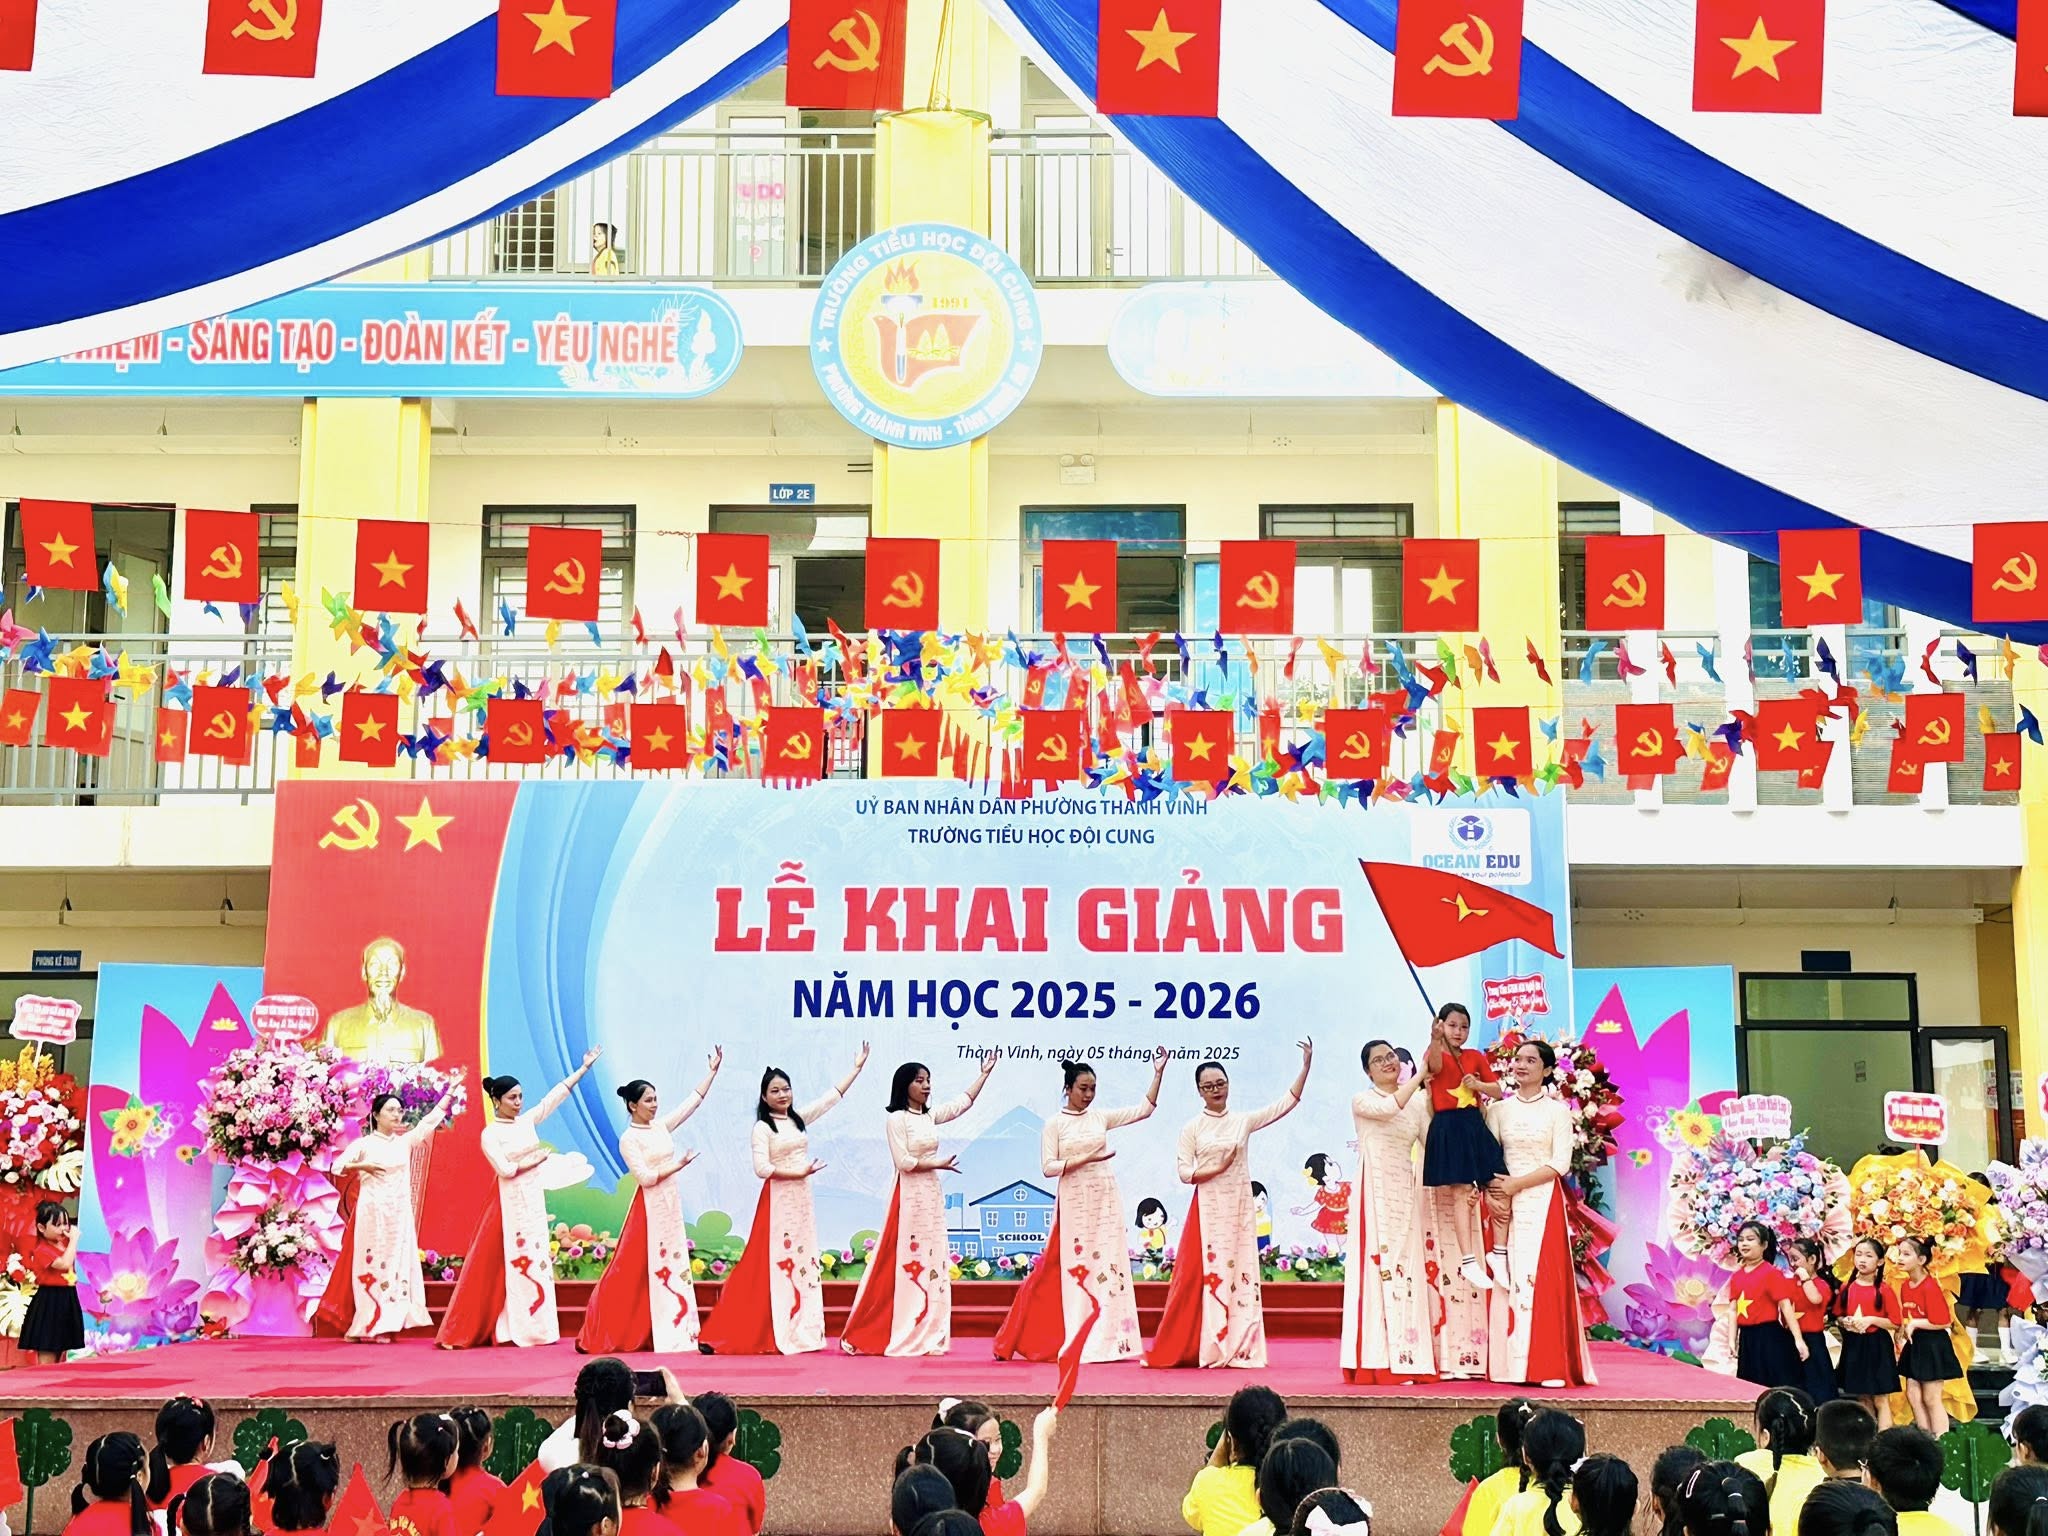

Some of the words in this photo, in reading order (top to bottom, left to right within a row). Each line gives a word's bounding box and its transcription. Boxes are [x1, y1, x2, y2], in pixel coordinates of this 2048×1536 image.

[869, 226, 916, 258] TIỂU
[922, 231, 966, 252] HỌC
[969, 243, 1004, 274] ĐỘI
[1002, 272, 1033, 330] CUNG
[280, 321, 333, 370] TẠO
[363, 314, 443, 362] ĐOÀN
[454, 310, 506, 362] KẾT
[537, 315, 589, 363] YÊU
[600, 311, 676, 363] NGHỀ
[909, 425, 942, 441] VINH
[773, 486, 793, 499] LỚP
[796, 489, 810, 499] 2E
[856, 795, 879, 815] UỶ
[884, 799, 920, 815] BAN
[924, 797, 974, 815] NHÂN
[979, 798, 1016, 815] DÂN
[1021, 796, 1097, 815] PHƯỜNG
[1165, 800, 1207, 815] VINH
[908, 826, 981, 844] TRƯỜNG
[986, 824, 1022, 844] TIỂU
[1028, 828, 1065, 848] HỌC
[1069, 826, 1101, 848] ĐỘI
[1105, 828, 1155, 844] CUNG
[1422, 854, 1480, 869] OCEAN
[1486, 854, 1520, 869] EDU
[714, 861, 815, 952] LỄ
[843, 887, 1047, 952] KHAI
[1079, 869, 1344, 953] GIẢNG
[794, 971, 893, 1018] NĂM
[908, 979, 998, 1030] HỌC
[1011, 981, 1115, 1019] 2025
[1154, 981, 1260, 1019] 2026
[957, 1045, 1003, 1059] Thành
[1008, 1045, 1043, 1061] Vinh,
[1047, 1045, 1084, 1062] ngày
[1087, 1046, 1105, 1059] 05
[1109, 1046, 1152, 1062] tháng
[1168, 1046, 1200, 1059] năm
[1204, 1046, 1240, 1059] 2025
[998, 1233, 1045, 1241] SCHOOL
